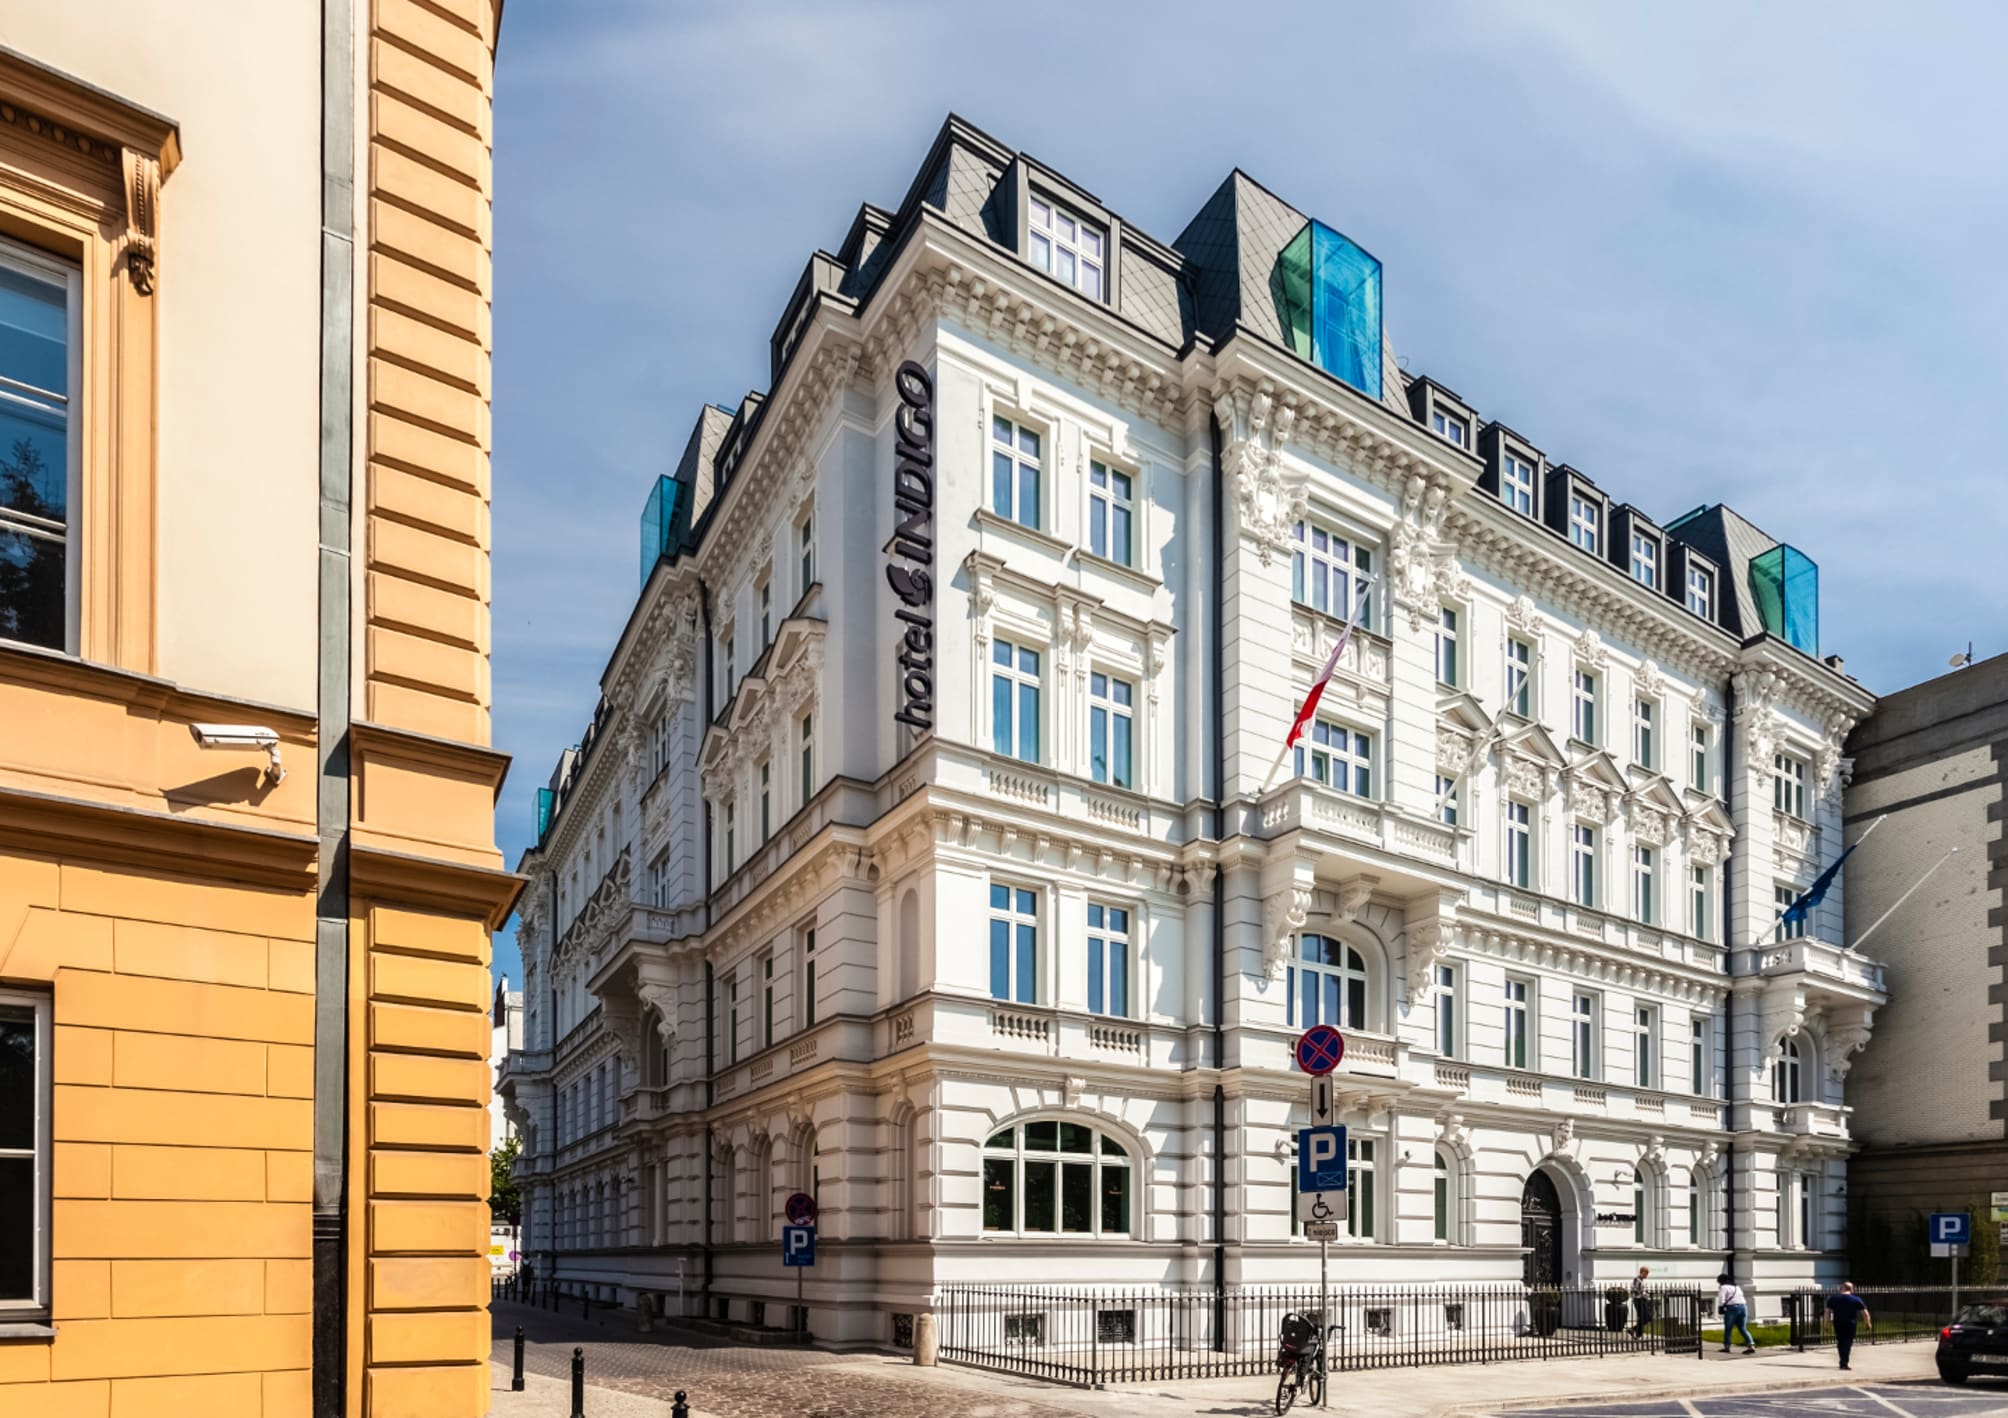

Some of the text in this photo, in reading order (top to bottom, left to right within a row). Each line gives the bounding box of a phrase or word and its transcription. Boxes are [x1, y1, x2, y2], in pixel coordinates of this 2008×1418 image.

[895, 360, 932, 729] hotel INDIGO
[1309, 1133, 1336, 1173] P
[790, 1230, 808, 1255] P
[1939, 1217, 1961, 1239] P
